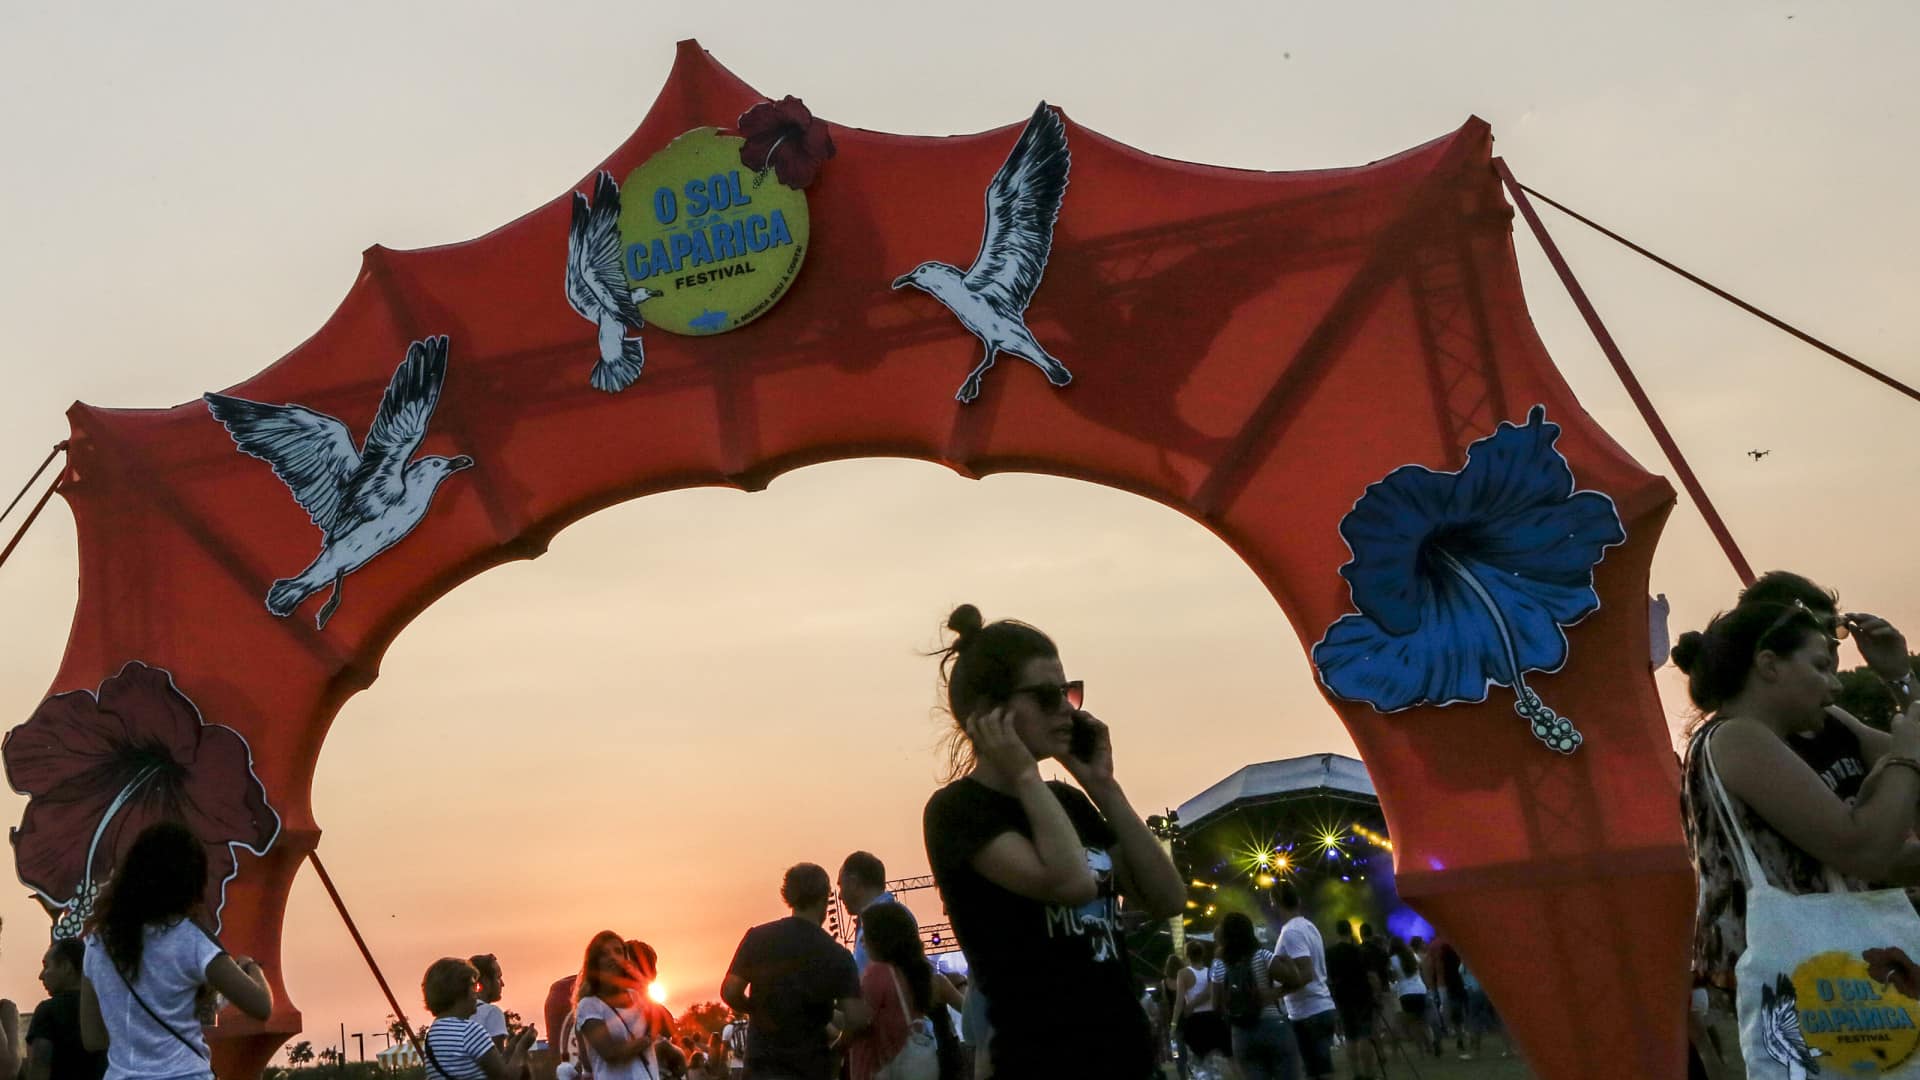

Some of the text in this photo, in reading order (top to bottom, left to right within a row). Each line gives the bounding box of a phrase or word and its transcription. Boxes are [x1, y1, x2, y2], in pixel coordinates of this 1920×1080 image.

[654, 171, 751, 224] O SOL
[626, 208, 793, 282] CAPARICA
[675, 261, 756, 290] FESTIVAL
[1817, 978, 1882, 1002] O SOL
[1801, 1007, 1915, 1033] CAPARICA
[1836, 1033, 1893, 1044] FESTIVAL
